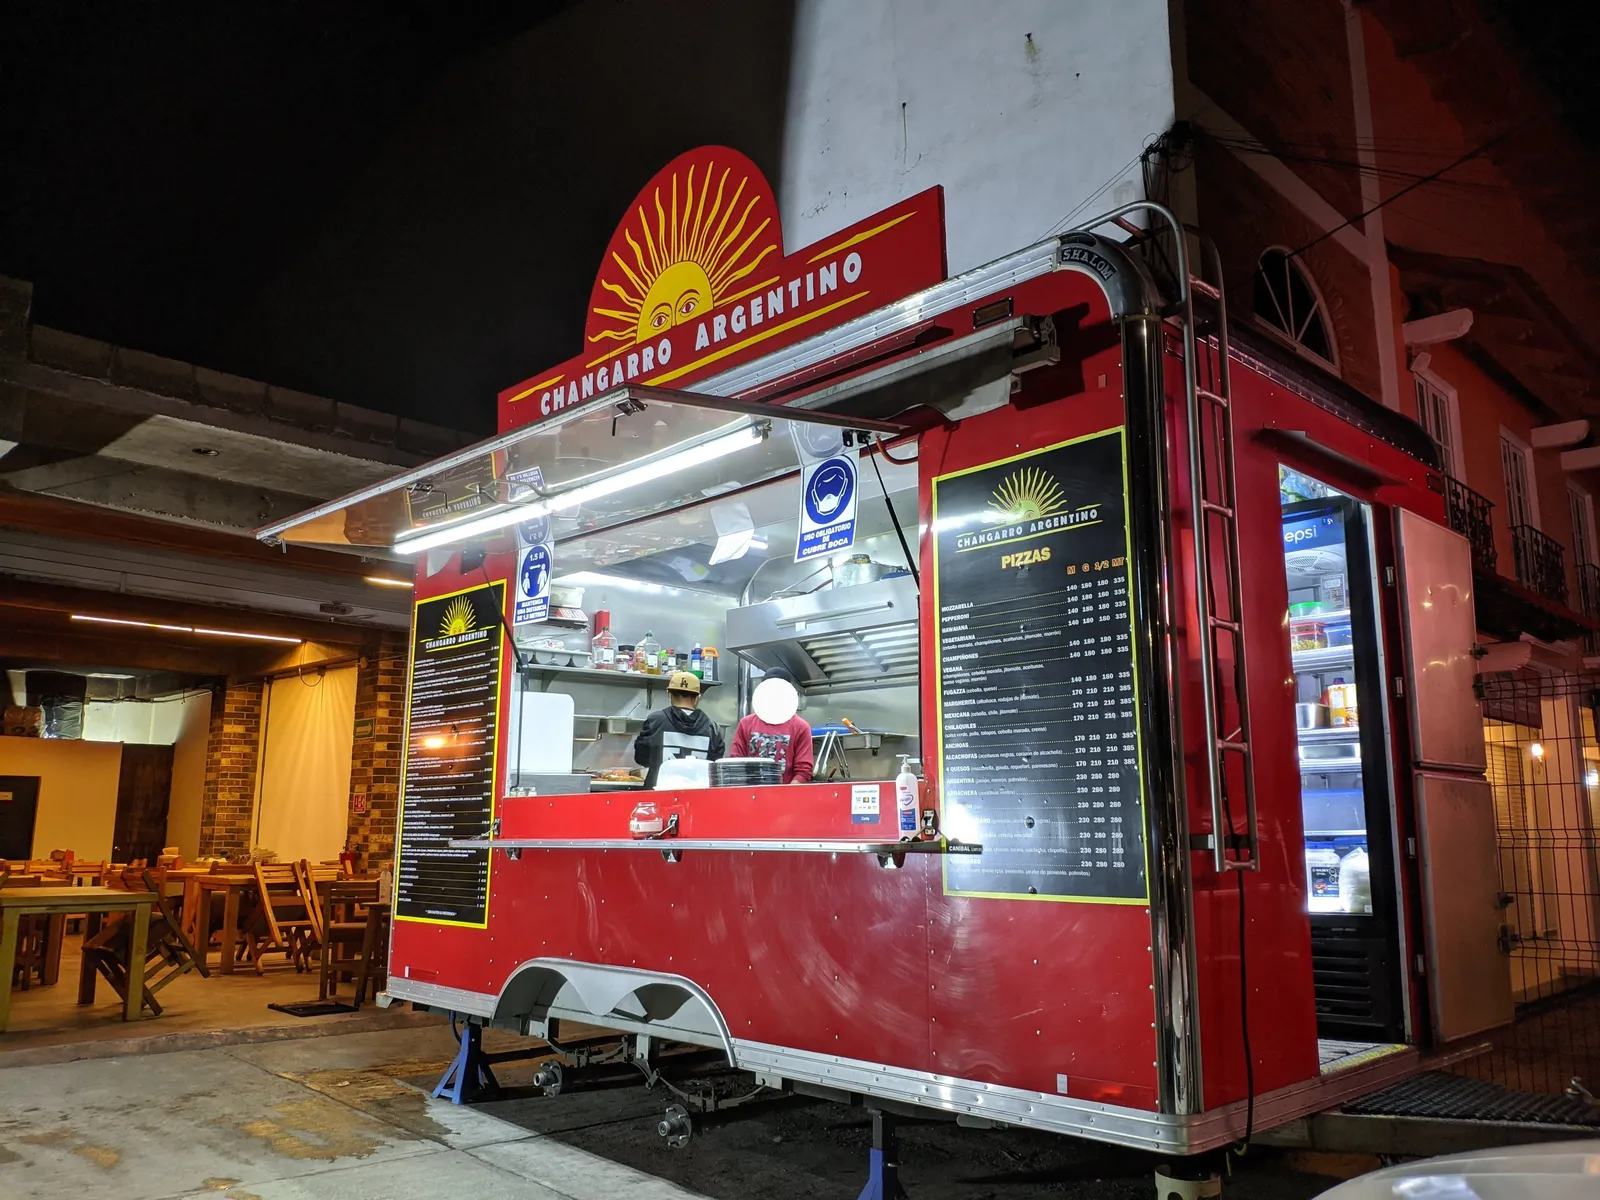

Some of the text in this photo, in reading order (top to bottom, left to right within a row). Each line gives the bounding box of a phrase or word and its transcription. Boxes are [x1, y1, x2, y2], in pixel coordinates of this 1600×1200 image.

[1062, 248, 1114, 280] SHALOM
[540, 252, 862, 416] CHANGARRO ARGENTINO
[804, 523, 851, 542] USO OBLIGATORIO
[957, 508, 1098, 548] CHANGARRO ARGENTINO
[1284, 525, 1317, 544] epsi
[802, 537, 848, 555] CUBRE BOCA
[530, 553, 538, 561] 1.5
[1001, 547, 1051, 569] PIZZAS
[1066, 556, 1124, 575] M G 1/2 MT
[941, 602, 973, 612] MOZZARELLA
[1113, 575, 1124, 583] 335
[522, 598, 543, 608] MANTENGA
[526, 604, 546, 613] DISTANCIA
[530, 611, 546, 619] METROS
[941, 614, 969, 622] PEPPERONI
[942, 625, 968, 633] HAWAIANA
[426, 630, 487, 649] CHANGARRO ARGENTINO
[942, 634, 975, 644] VEGETARIANA
[942, 652, 978, 662] CHAMPIÑONES
[680, 677, 688, 688] LA
[943, 699, 975, 707] MARGHERITA
